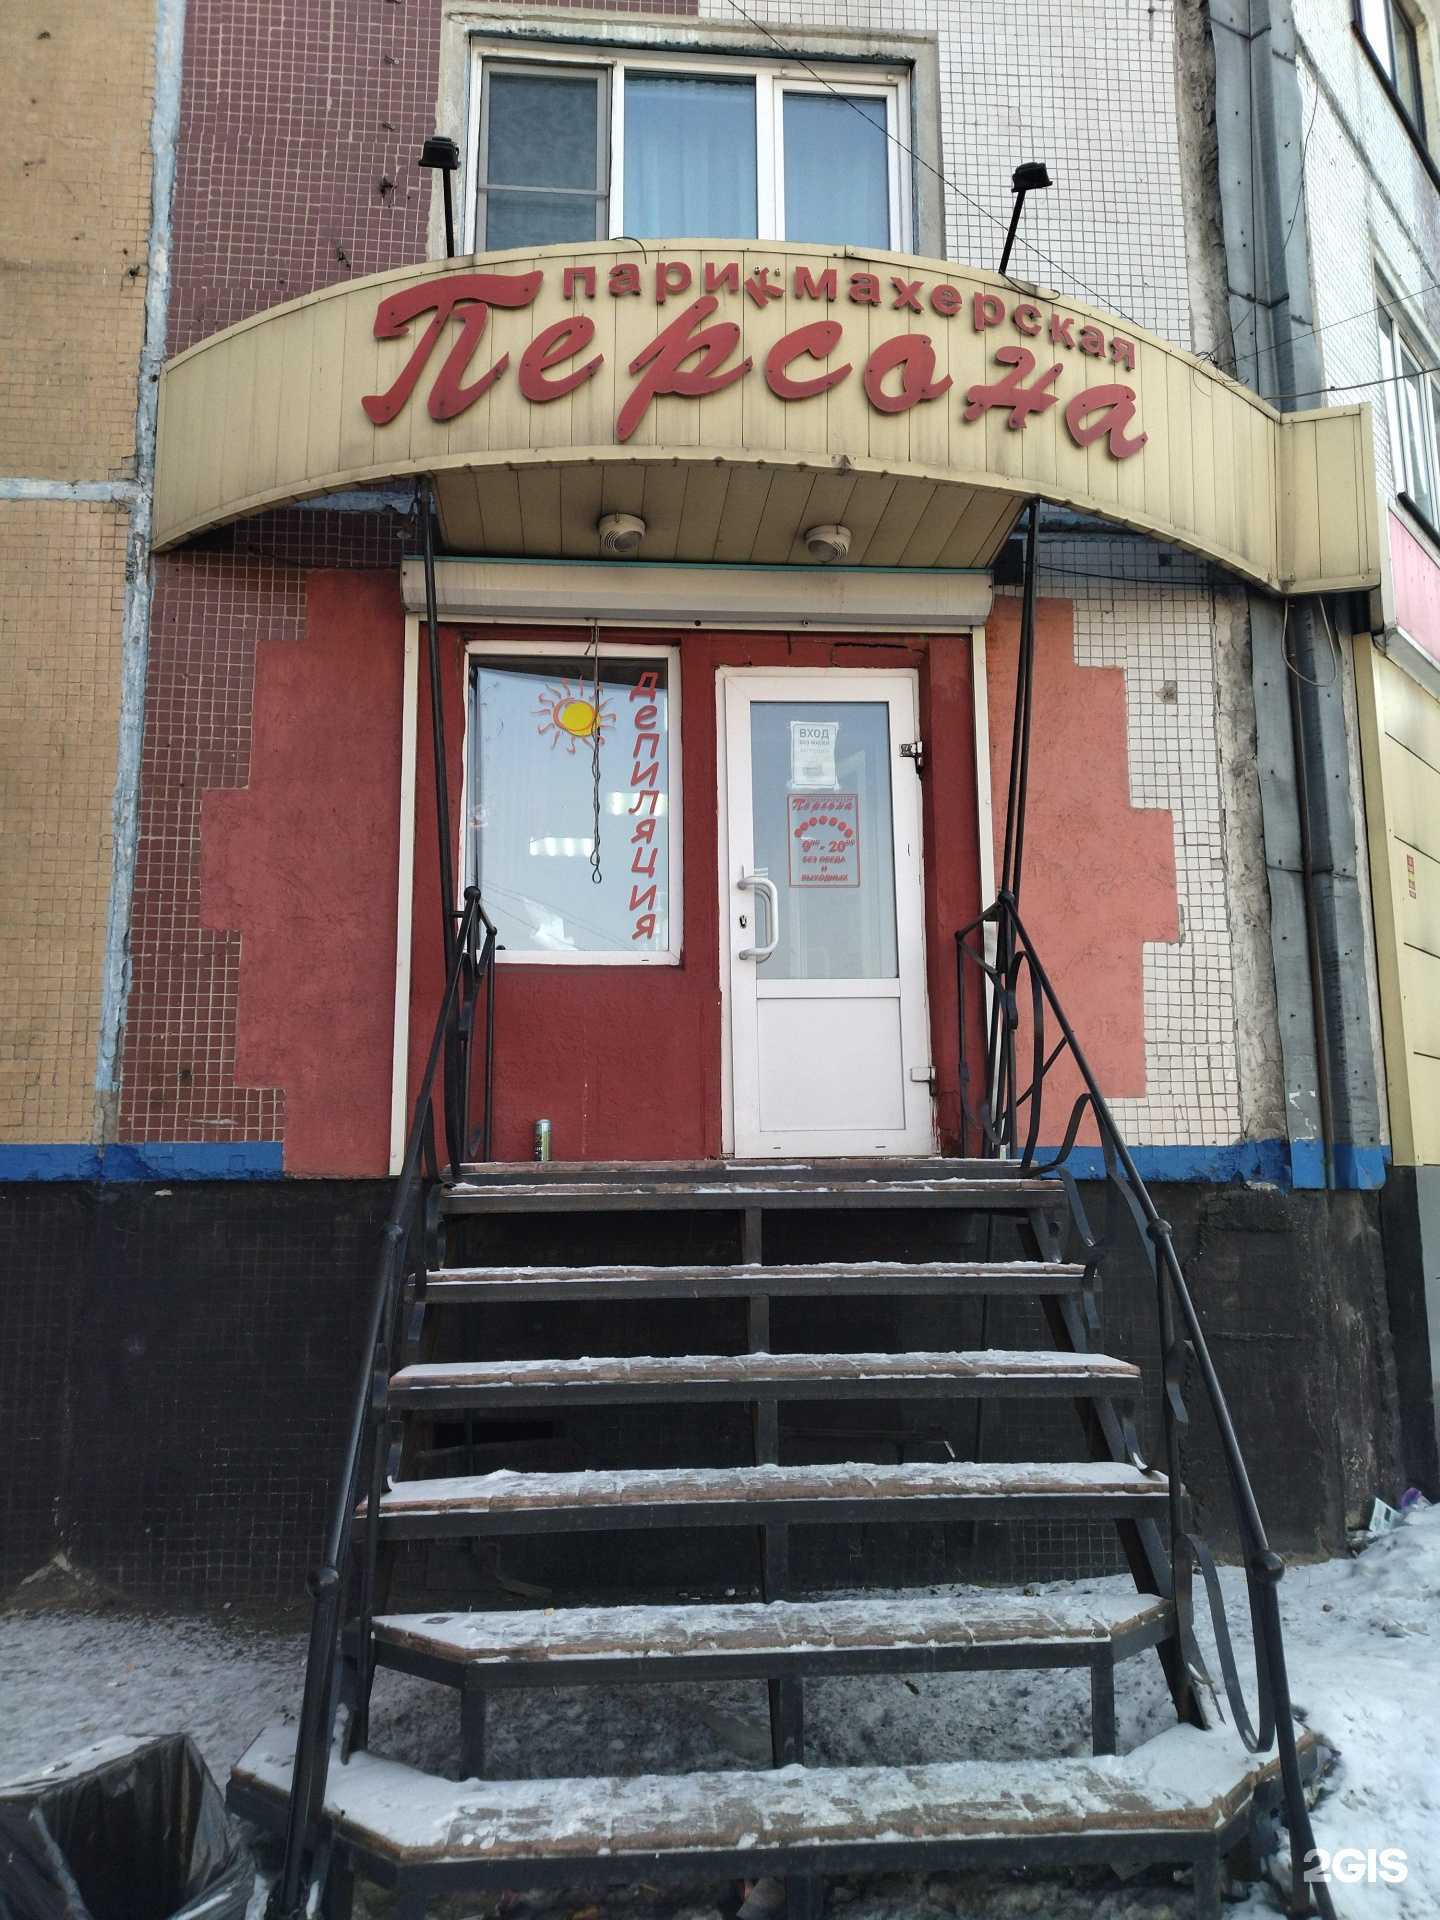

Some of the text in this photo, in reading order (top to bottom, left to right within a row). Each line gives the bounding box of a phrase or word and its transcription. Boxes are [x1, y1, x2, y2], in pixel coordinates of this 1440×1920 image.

[360, 271, 1149, 461] Персона
[562, 260, 1137, 370] парикмахерская
[799, 728, 830, 740] ВХОД
